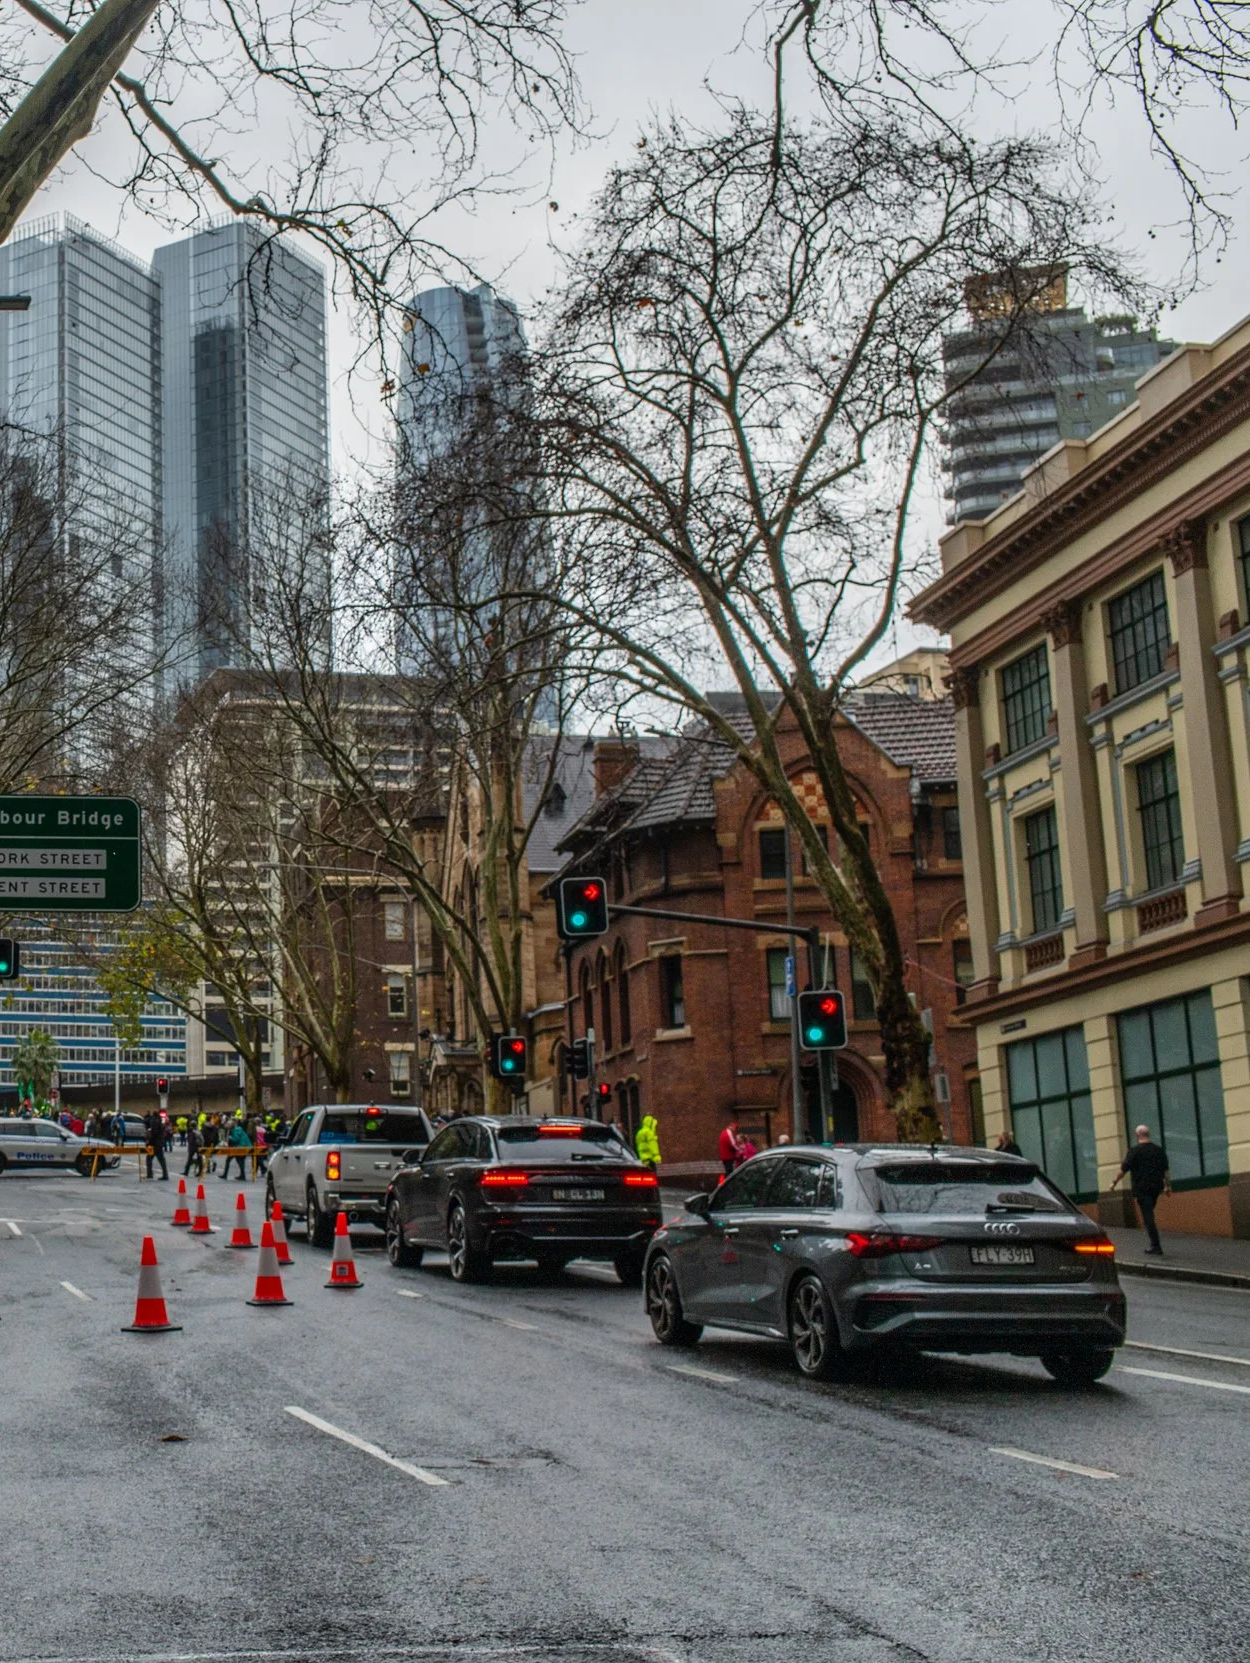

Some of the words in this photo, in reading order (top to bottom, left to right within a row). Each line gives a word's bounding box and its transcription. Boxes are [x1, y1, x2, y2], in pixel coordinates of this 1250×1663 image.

[57, 810, 124, 830] Bridge
[40, 853, 103, 865] STREET
[39, 882, 102, 894] STREET
[16, 1152, 55, 1161] Police
